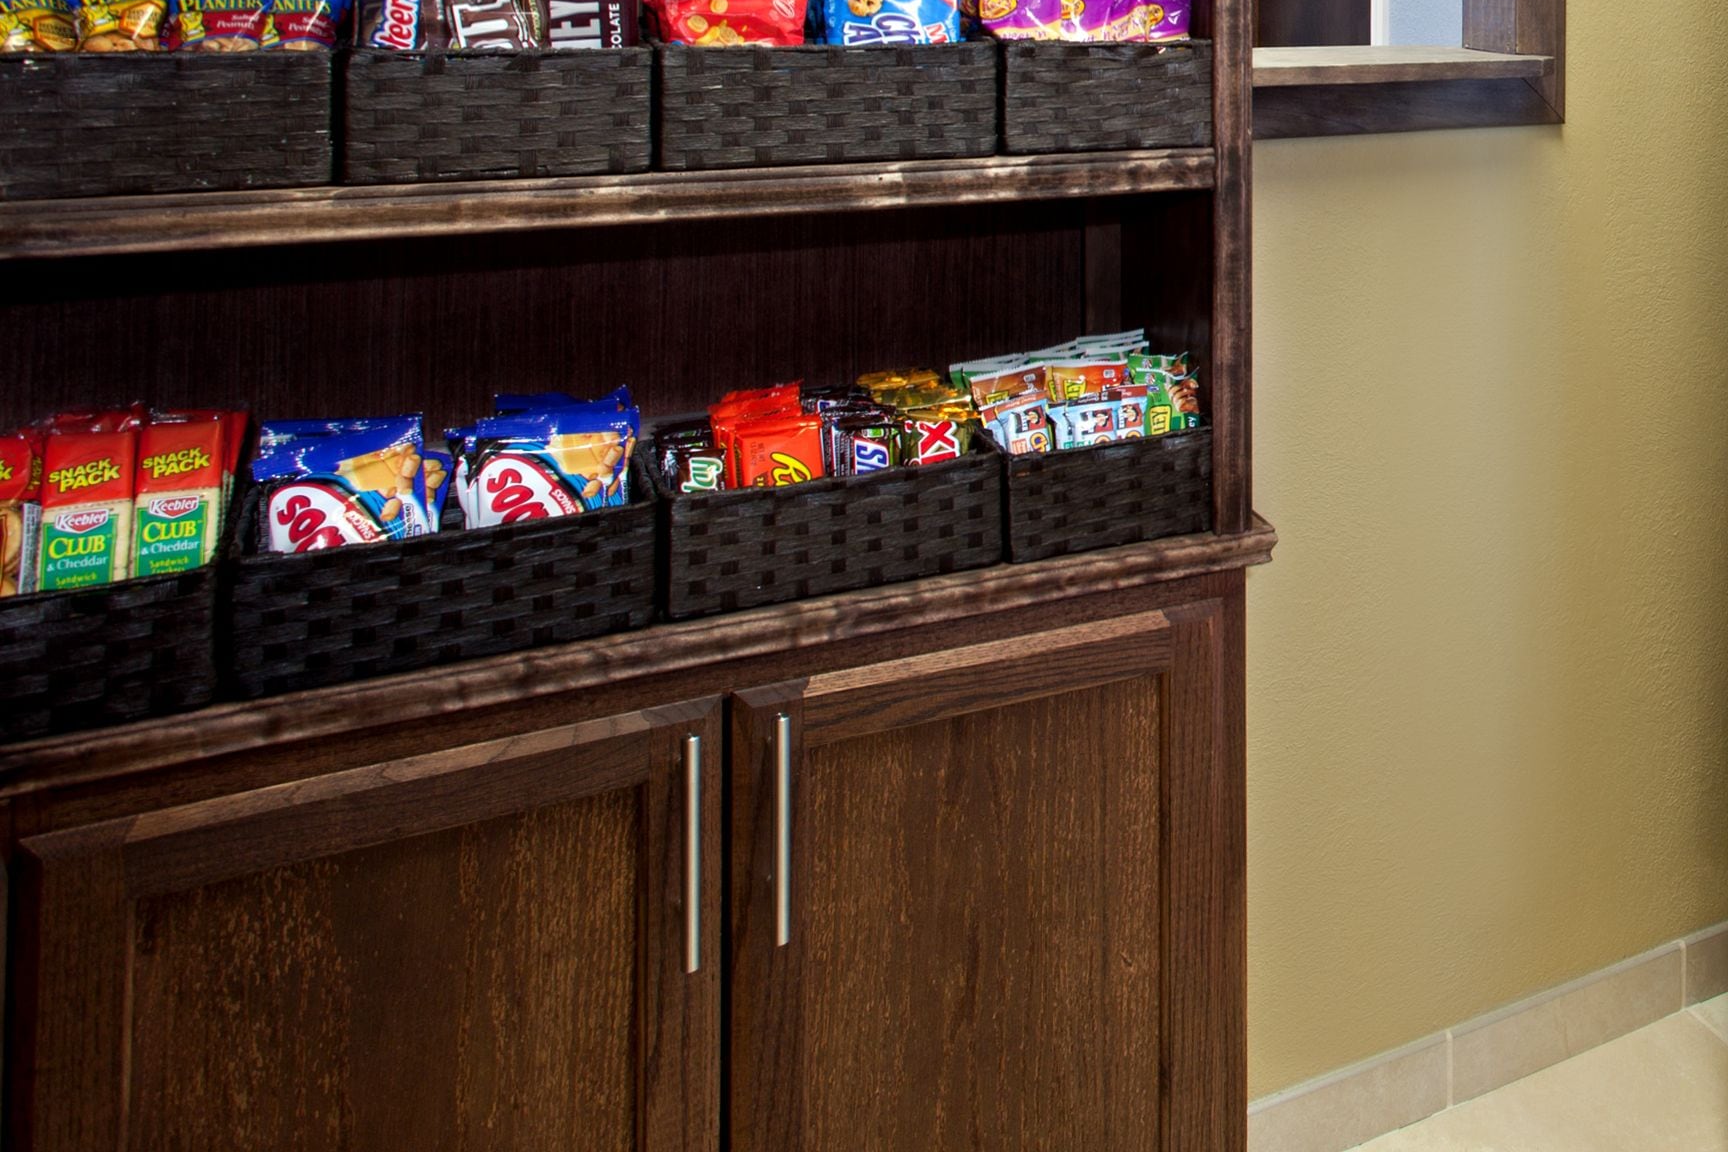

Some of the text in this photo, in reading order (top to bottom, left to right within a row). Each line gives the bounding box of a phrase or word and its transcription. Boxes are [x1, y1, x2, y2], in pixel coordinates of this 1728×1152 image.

[142, 447, 202, 469] SNACK
[152, 454, 211, 478] PACK
[49, 458, 111, 484] SNACK
[59, 465, 121, 493] PACK
[152, 497, 198, 513] Keebler
[57, 511, 107, 529] Keebler
[142, 520, 197, 543] CLUB
[48, 534, 106, 560] CLUB
[150, 540, 200, 555] Cheddar
[56, 554, 108, 571] Cheddar
